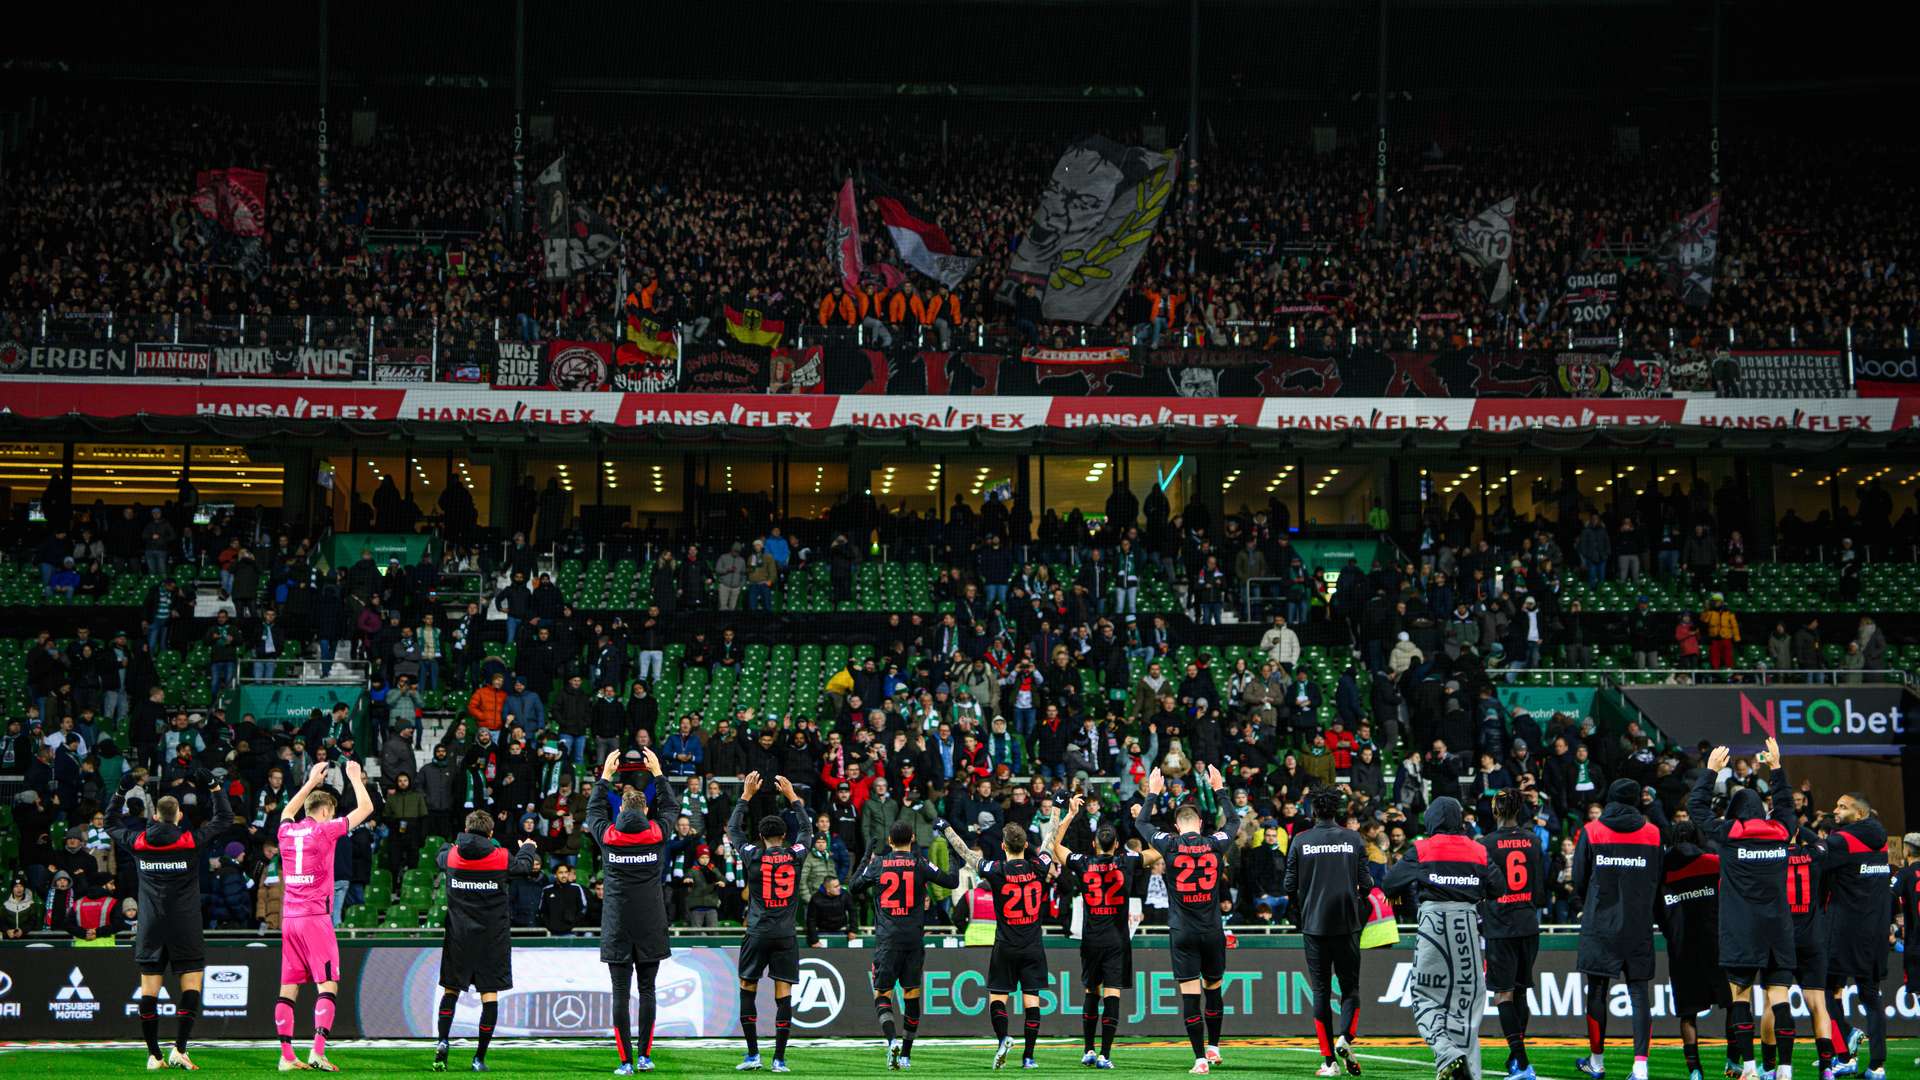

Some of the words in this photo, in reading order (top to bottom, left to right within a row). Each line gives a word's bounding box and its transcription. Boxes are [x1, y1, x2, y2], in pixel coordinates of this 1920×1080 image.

[513, 112, 523, 151] 107
[1378, 128, 1387, 167] 103
[1711, 128, 1720, 166] 101
[29, 346, 127, 371] ERBEN
[137, 351, 208, 369] DJANGOS
[498, 343, 541, 359] WEST
[498, 359, 539, 375] SIDE
[496, 374, 538, 386] BOYZ
[1740, 690, 1905, 739] NEO.bet
[293, 835, 305, 875] 1
[608, 852, 658, 864] Barmenia
[1302, 842, 1354, 856] Barmenia
[1737, 846, 1787, 859] Barmenia
[139, 859, 188, 870] Barmenia
[1596, 854, 1647, 867] Barmenia
[1173, 852, 1218, 893] 23
[1505, 849, 1528, 891] 6
[451, 878, 498, 890] Barmenia
[760, 862, 797, 900] 19
[1082, 869, 1125, 907] 32
[1428, 873, 1480, 886] Barmenia
[1786, 864, 1810, 905] 11
[879, 871, 914, 909] 21
[1663, 886, 1715, 906] Barmenia
[764, 899, 789, 908] TELLA
[1000, 880, 1042, 919] 20
[891, 907, 909, 916] ADLI
[49, 1001, 100, 1011] MITSUBISHI
[56, 1009, 93, 1019] MOTORS
